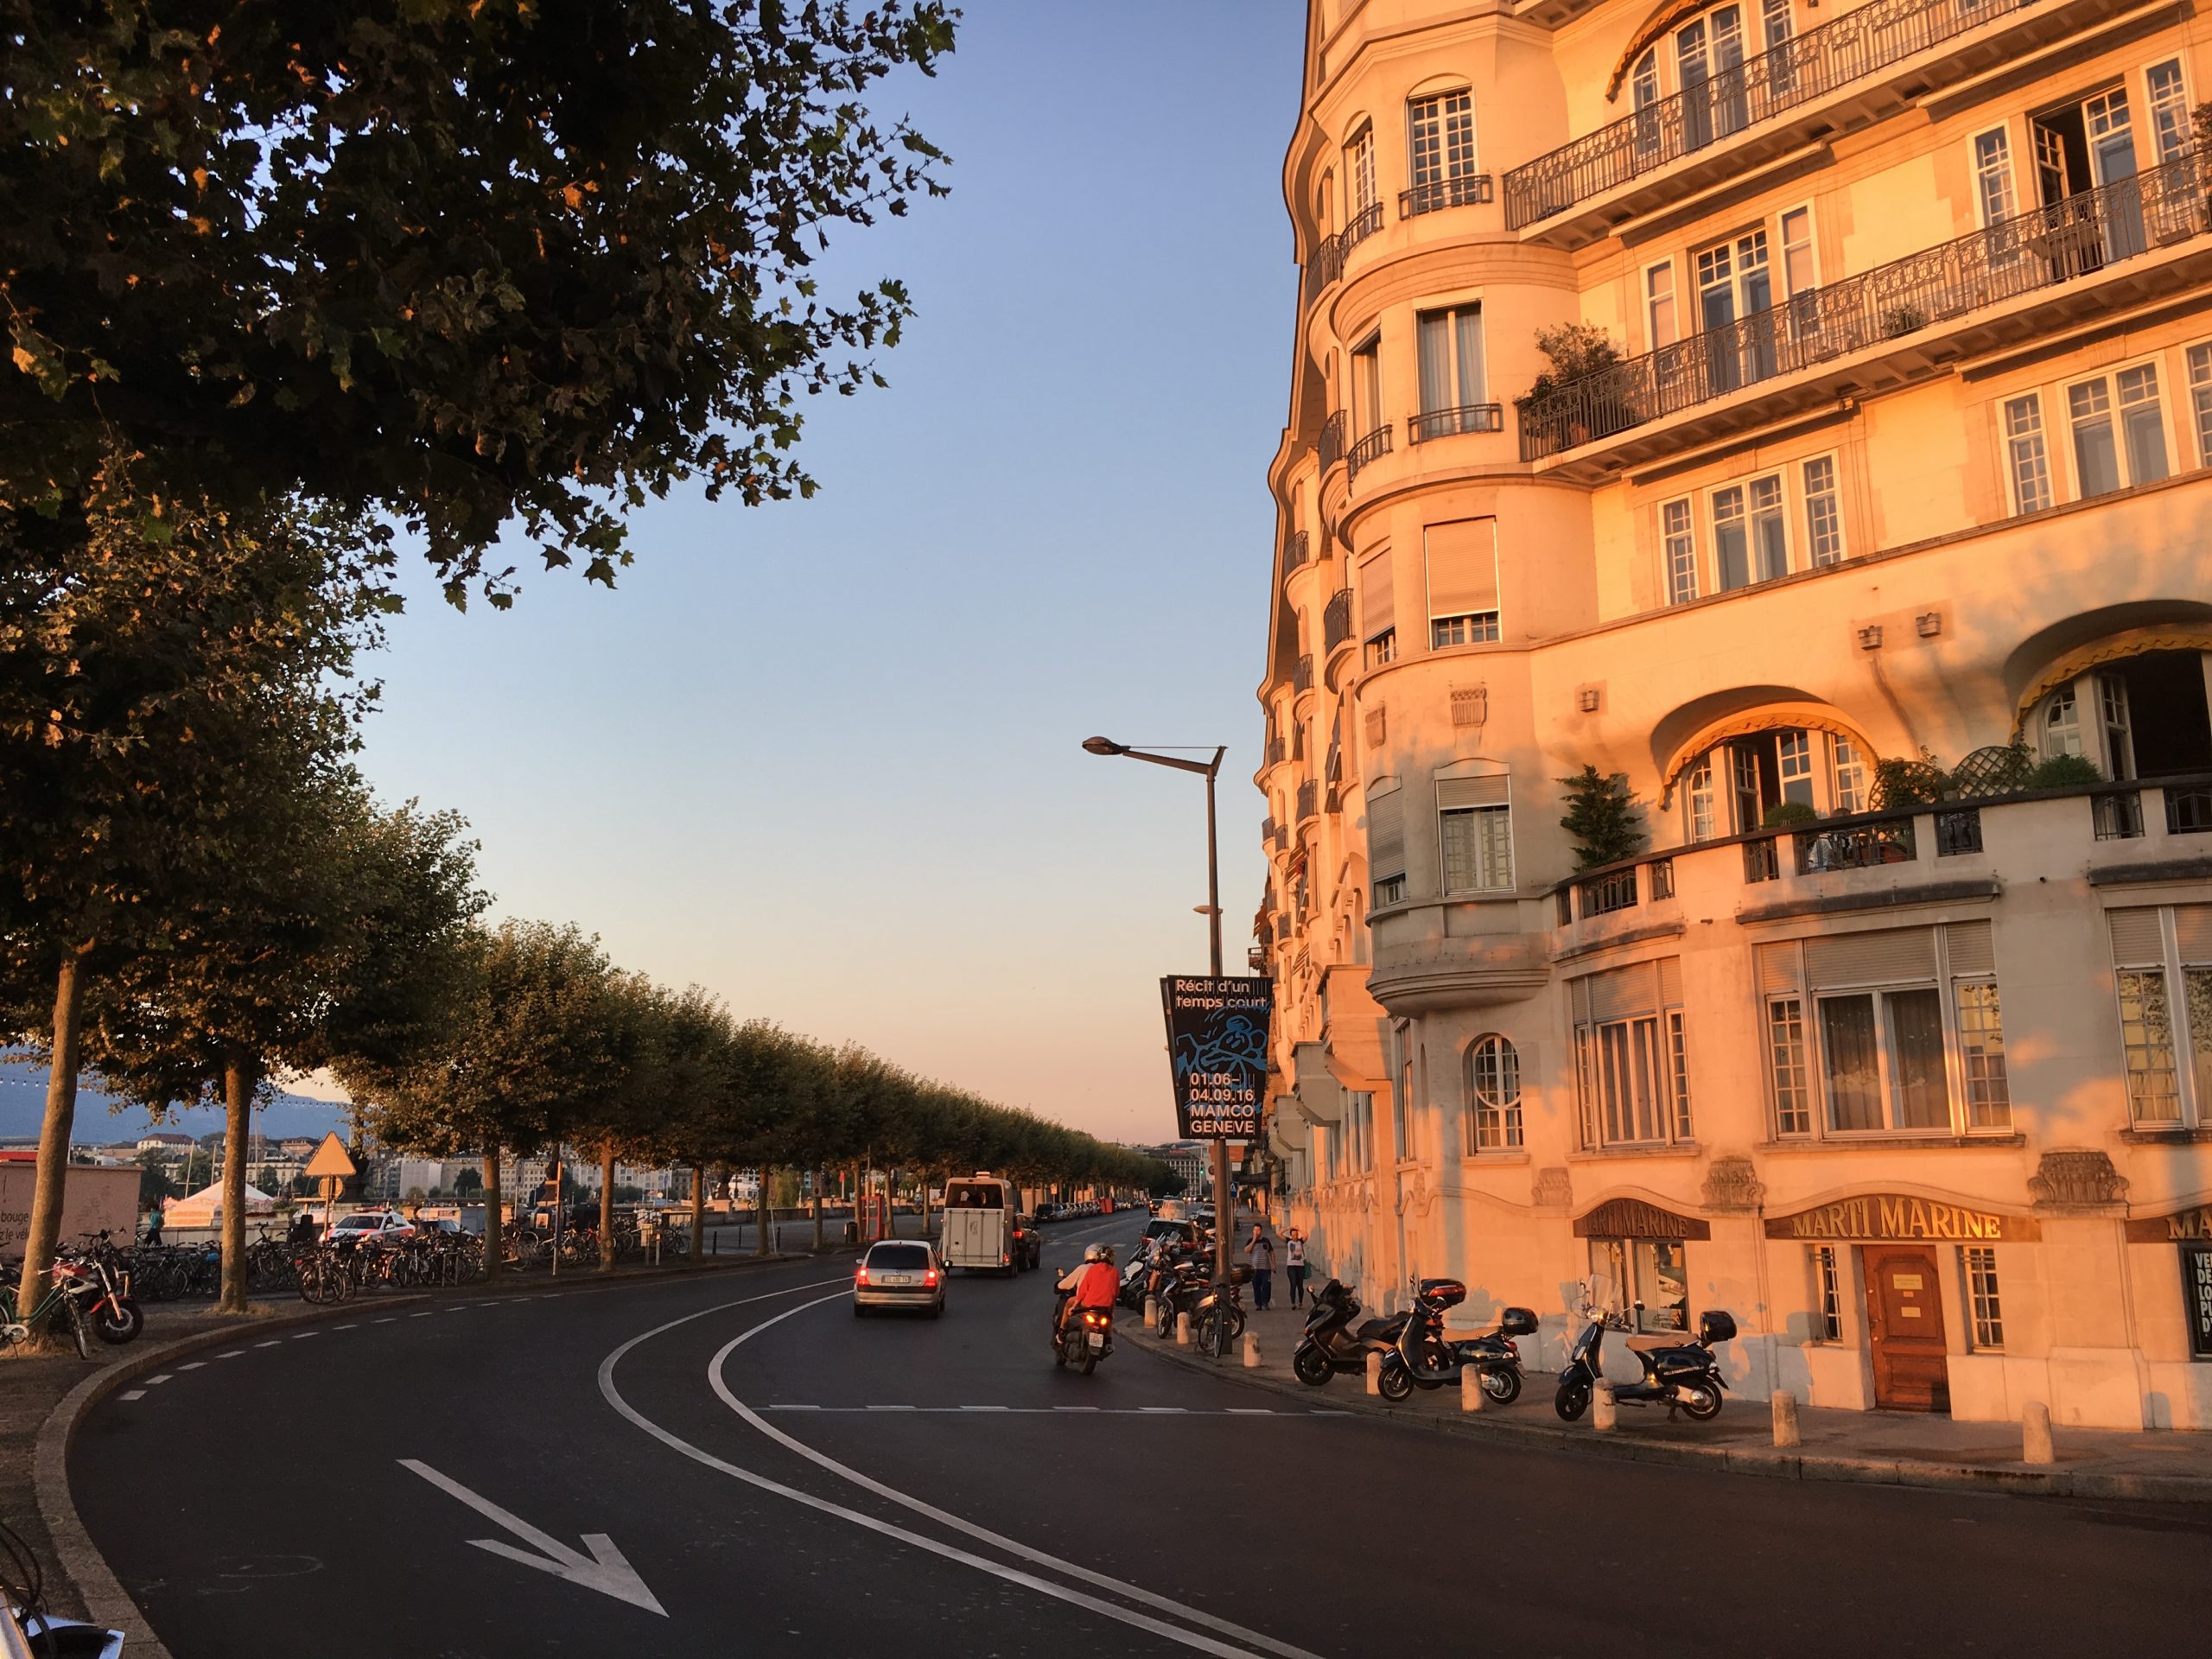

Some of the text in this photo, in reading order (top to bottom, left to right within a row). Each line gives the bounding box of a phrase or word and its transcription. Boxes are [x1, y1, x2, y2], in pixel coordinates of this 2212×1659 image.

[1176, 979, 1249, 993] Récit d'un
[1176, 995, 1267, 1010] temps court
[1191, 1088, 1254, 1101] 04.09.16
[1191, 1104, 1255, 1117] MAMCO
[1191, 1120, 1255, 1133] GENEVE
[1, 1210, 29, 1225] bouge
[1619, 1200, 1688, 1239] MARINE
[1791, 1197, 2002, 1239] MARTI MARINE
[6, 1228, 14, 1241] le
[2195, 1253, 2212, 1268] VE
